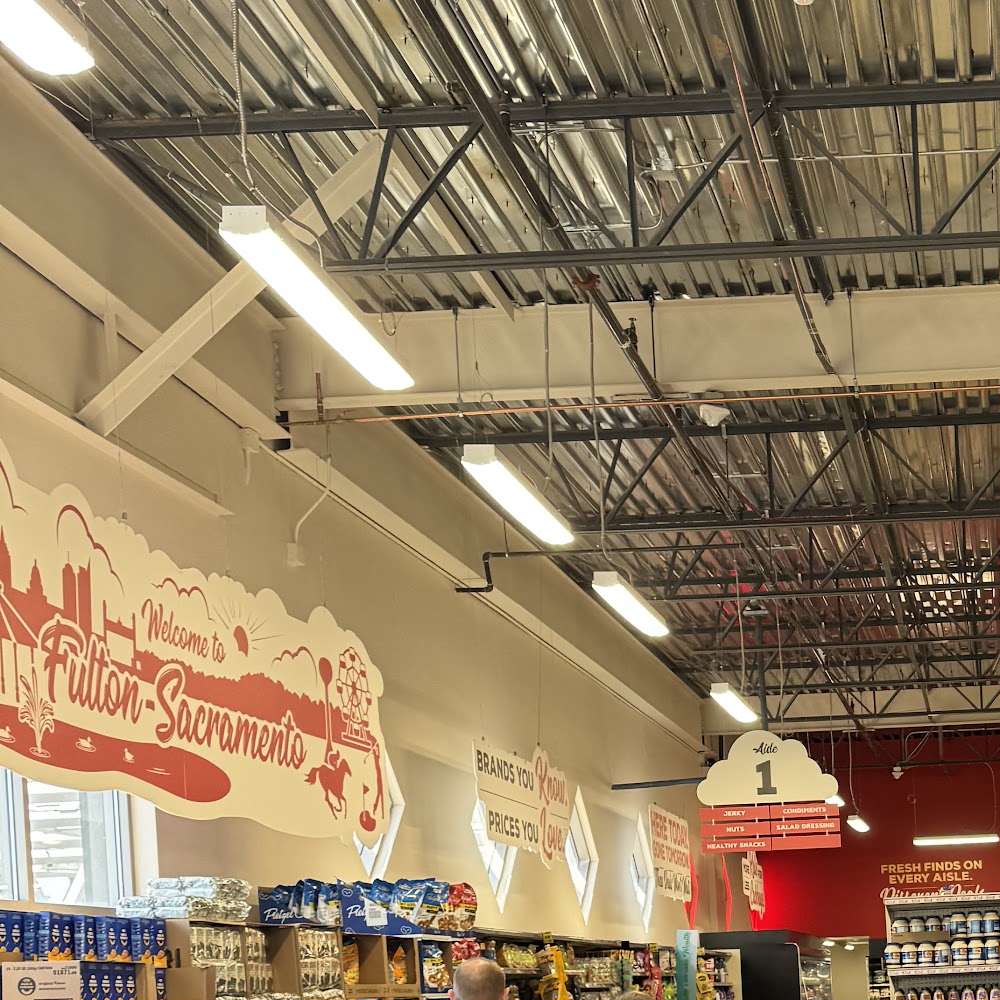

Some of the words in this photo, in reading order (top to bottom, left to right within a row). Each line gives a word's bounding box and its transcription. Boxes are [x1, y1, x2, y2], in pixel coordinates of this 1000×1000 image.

[141, 599, 210, 660] Welcome
[211, 631, 227, 663] to
[476, 749, 515, 784] BRANDS
[516, 765, 534, 791] YOU
[755, 759, 777, 795] 1
[488, 809, 520, 839] PRICES
[521, 819, 539, 844] YOU
[782, 806, 827, 814] CONDIMENTS
[880, 862, 922, 874] FRESH
[923, 860, 961, 872] FINDS
[963, 859, 983, 870] ON
[889, 873, 930, 885] EVERY
[932, 871, 973, 883] AISLE.
